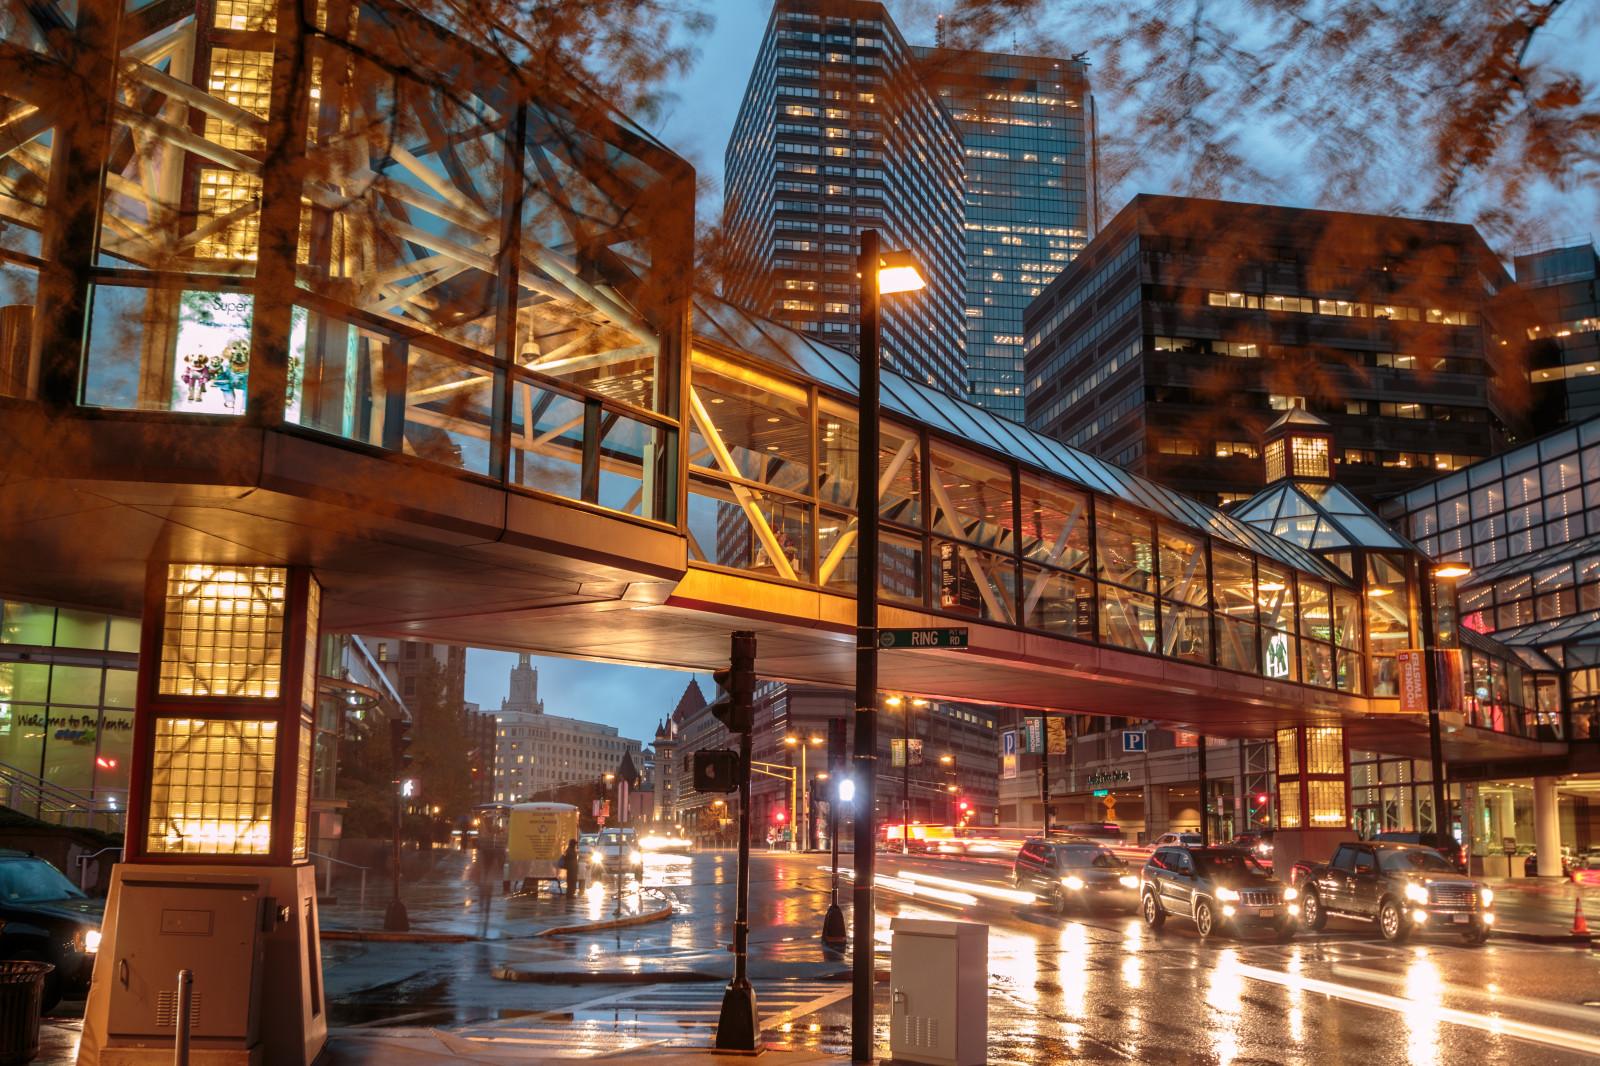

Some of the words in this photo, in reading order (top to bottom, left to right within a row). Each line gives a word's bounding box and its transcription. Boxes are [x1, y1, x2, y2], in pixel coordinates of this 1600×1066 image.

[213, 297, 248, 315] Super
[911, 631, 938, 646] RING
[950, 636, 960, 645] RD
[1411, 652, 1422, 699] TWISTED
[1405, 663, 1415, 708] HOOKED
[18, 713, 66, 728] Welcme
[69, 714, 80, 728] to
[1006, 735, 1013, 760] P
[1129, 734, 1140, 749] P
